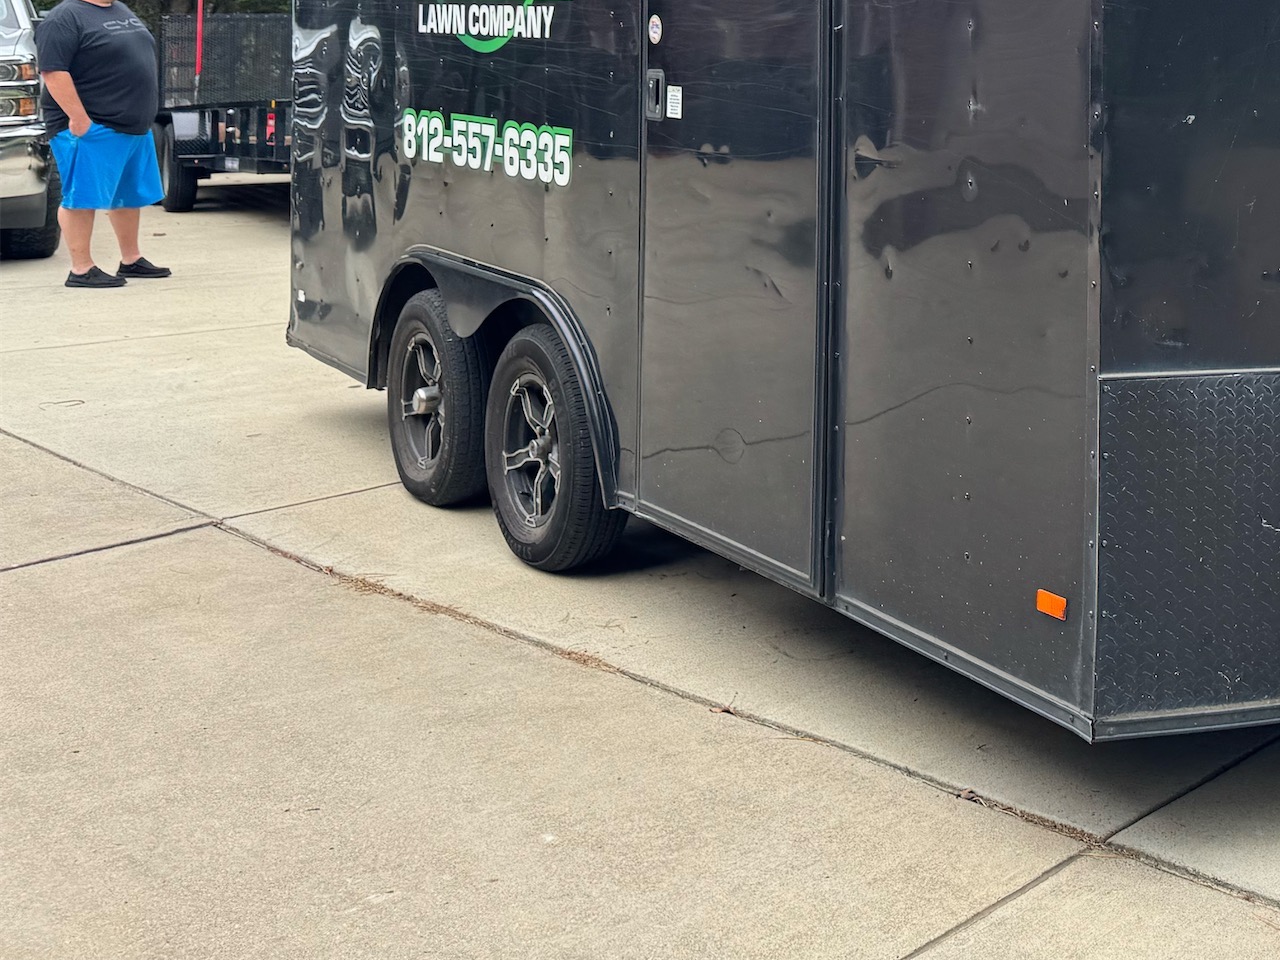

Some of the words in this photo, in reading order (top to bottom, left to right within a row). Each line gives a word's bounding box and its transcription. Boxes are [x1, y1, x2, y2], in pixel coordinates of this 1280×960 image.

[417, 3, 466, 35] LAWN
[468, 4, 555, 38] COMPANY
[402, 113, 571, 187] 812-557-6335
